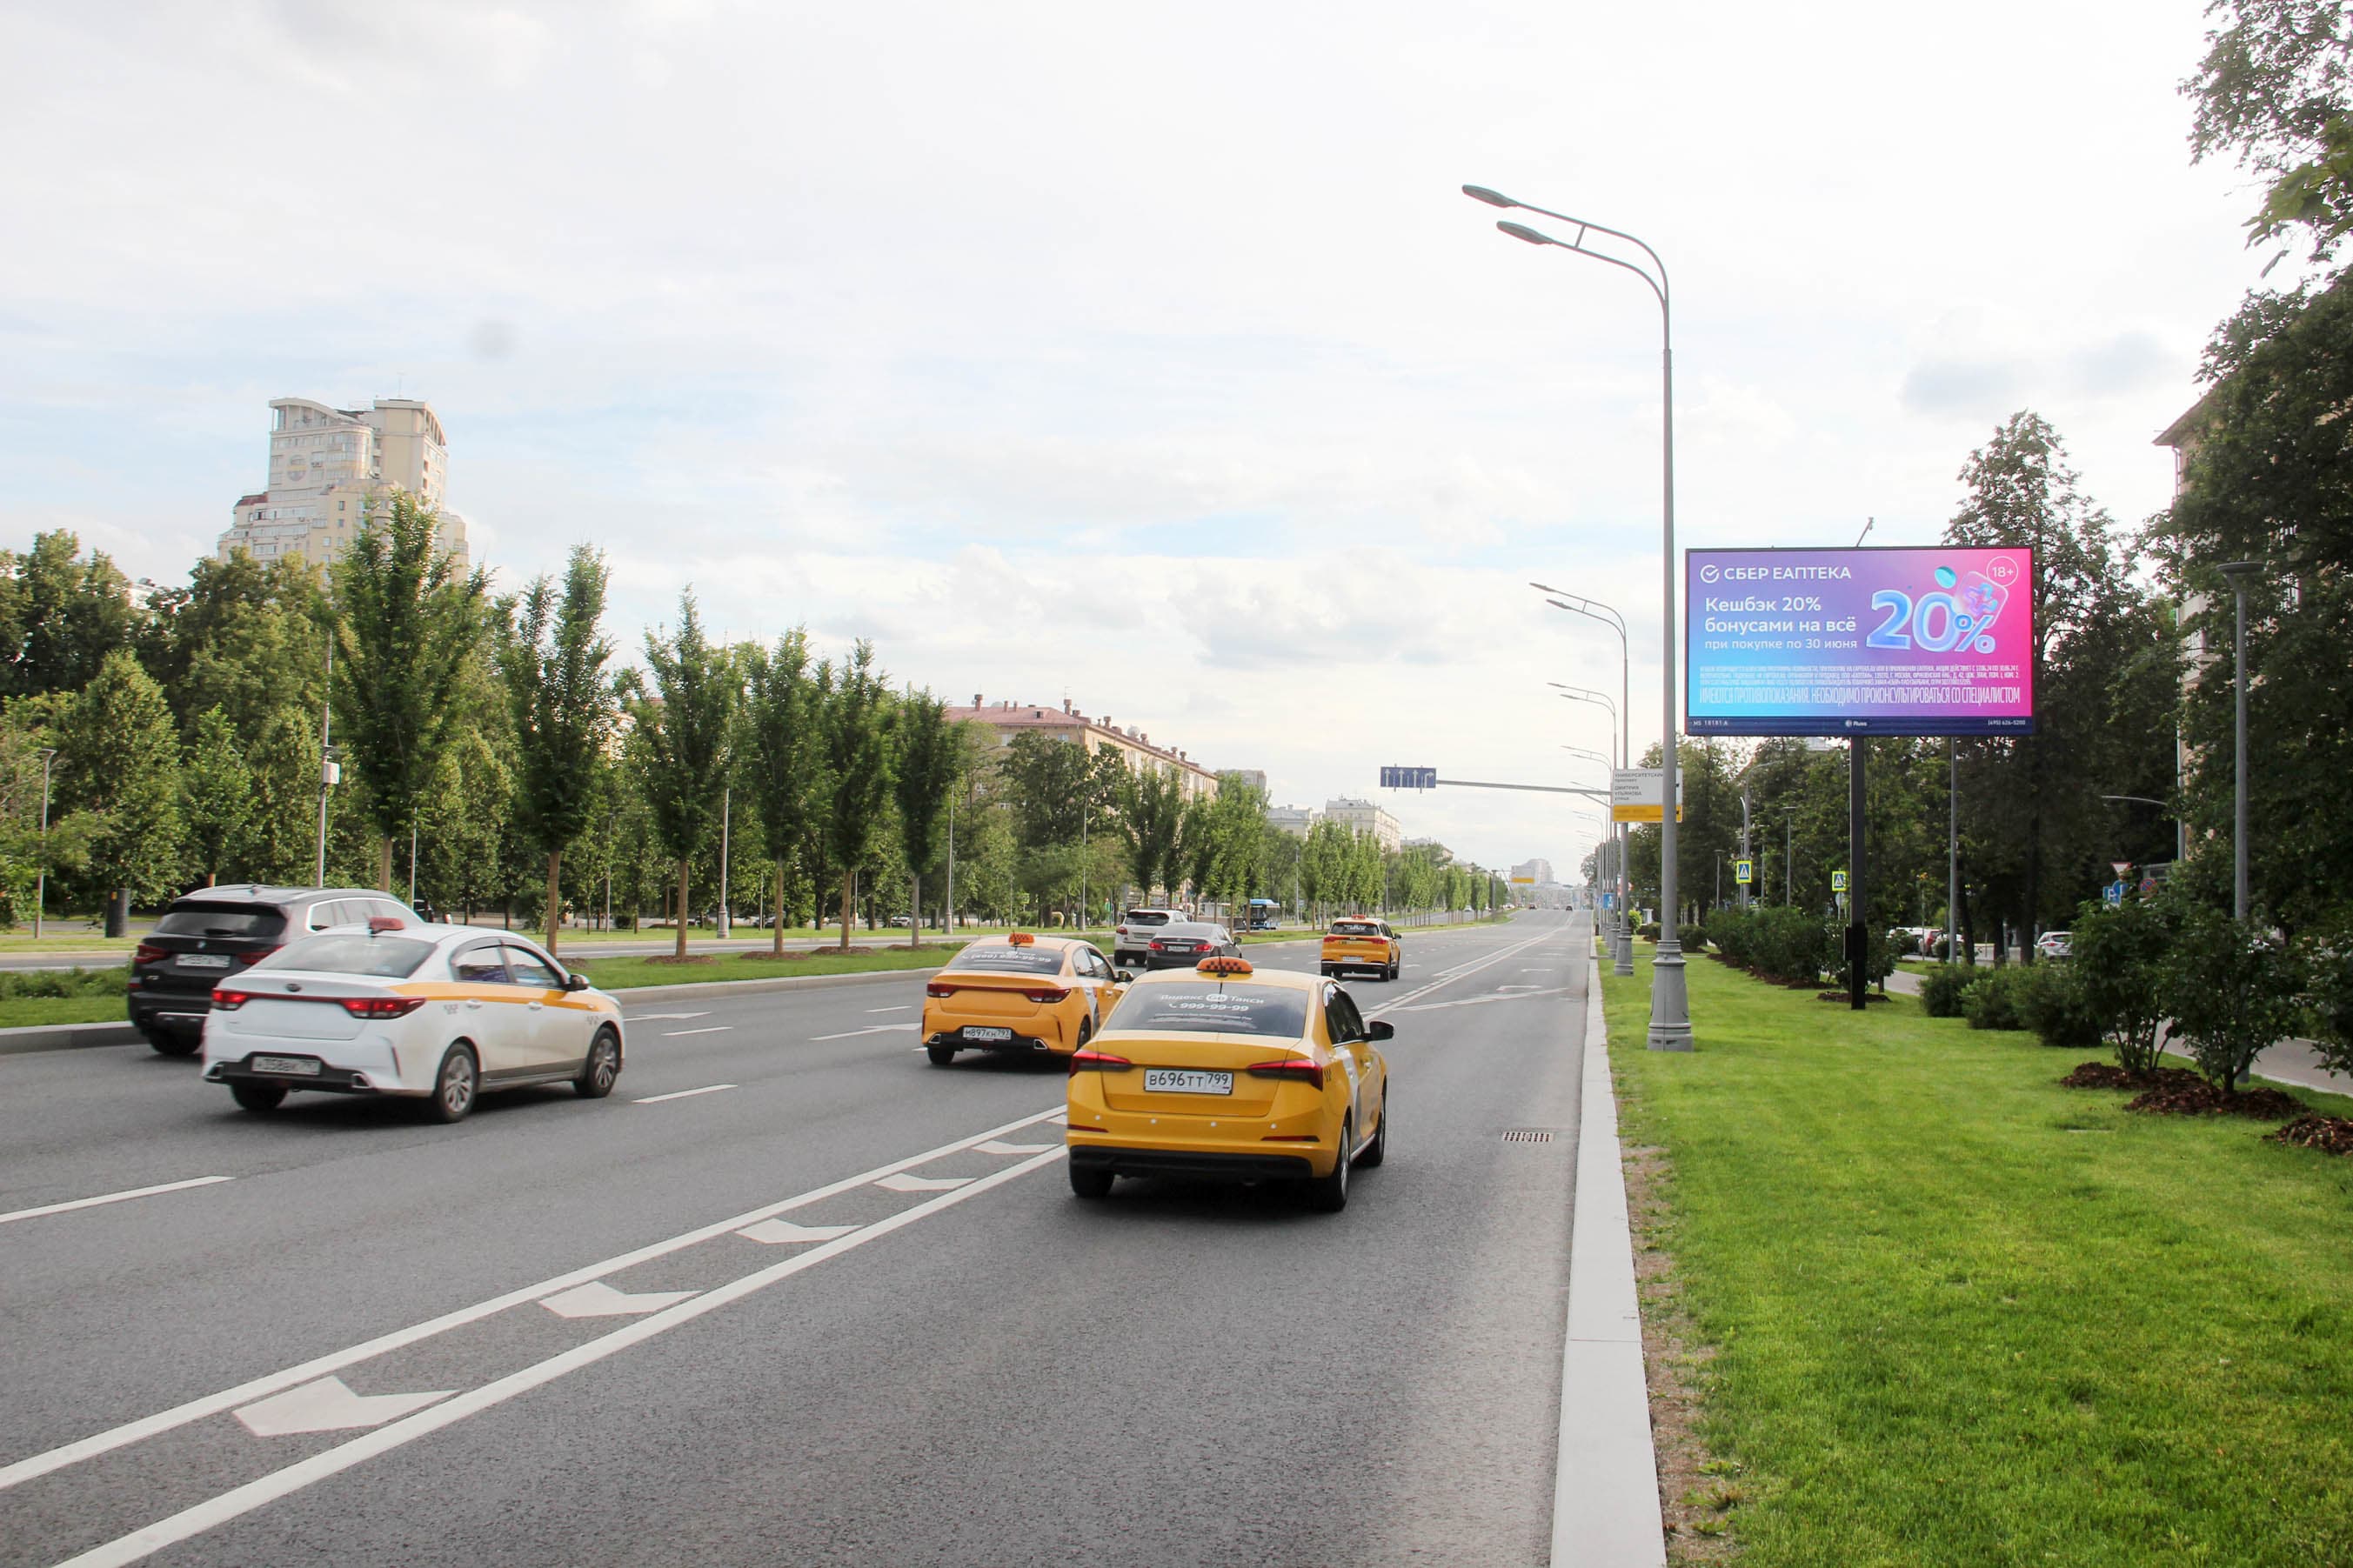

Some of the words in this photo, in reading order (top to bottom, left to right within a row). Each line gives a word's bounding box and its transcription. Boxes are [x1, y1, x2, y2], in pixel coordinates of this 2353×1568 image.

[1724, 567, 1768, 580] СБЕР
[1773, 566, 1852, 580] ЕАПТЕКА
[1991, 566, 2015, 577] 18+
[1705, 597, 1777, 611] Кешбэк
[1781, 597, 1822, 611] 20%
[1704, 617, 1793, 636] бонусами
[1798, 621, 1821, 632] на
[1825, 616, 1856, 632] всё
[1866, 589, 1996, 654] 20%
[1704, 640, 1728, 651] при
[1732, 640, 1782, 651] покупке
[1787, 640, 1802, 649] по
[1805, 638, 1821, 649] 30
[1824, 640, 1857, 649] июня
[1811, 687, 1861, 707] НЕОБХОДИМО
[1861, 687, 1949, 703] ПРОКОНСУЛЬТИРОВАТЬСЯ
[1951, 687, 1961, 703] СО
[1962, 687, 2021, 706] СПЕЦИАЛИСТОМ
[1180, 1002, 1249, 1011] 999-99-99
[1231, 995, 1265, 1004] Такси
[1149, 1072, 1204, 1087] В696ТТ
[1206, 1073, 1229, 1085] 799
